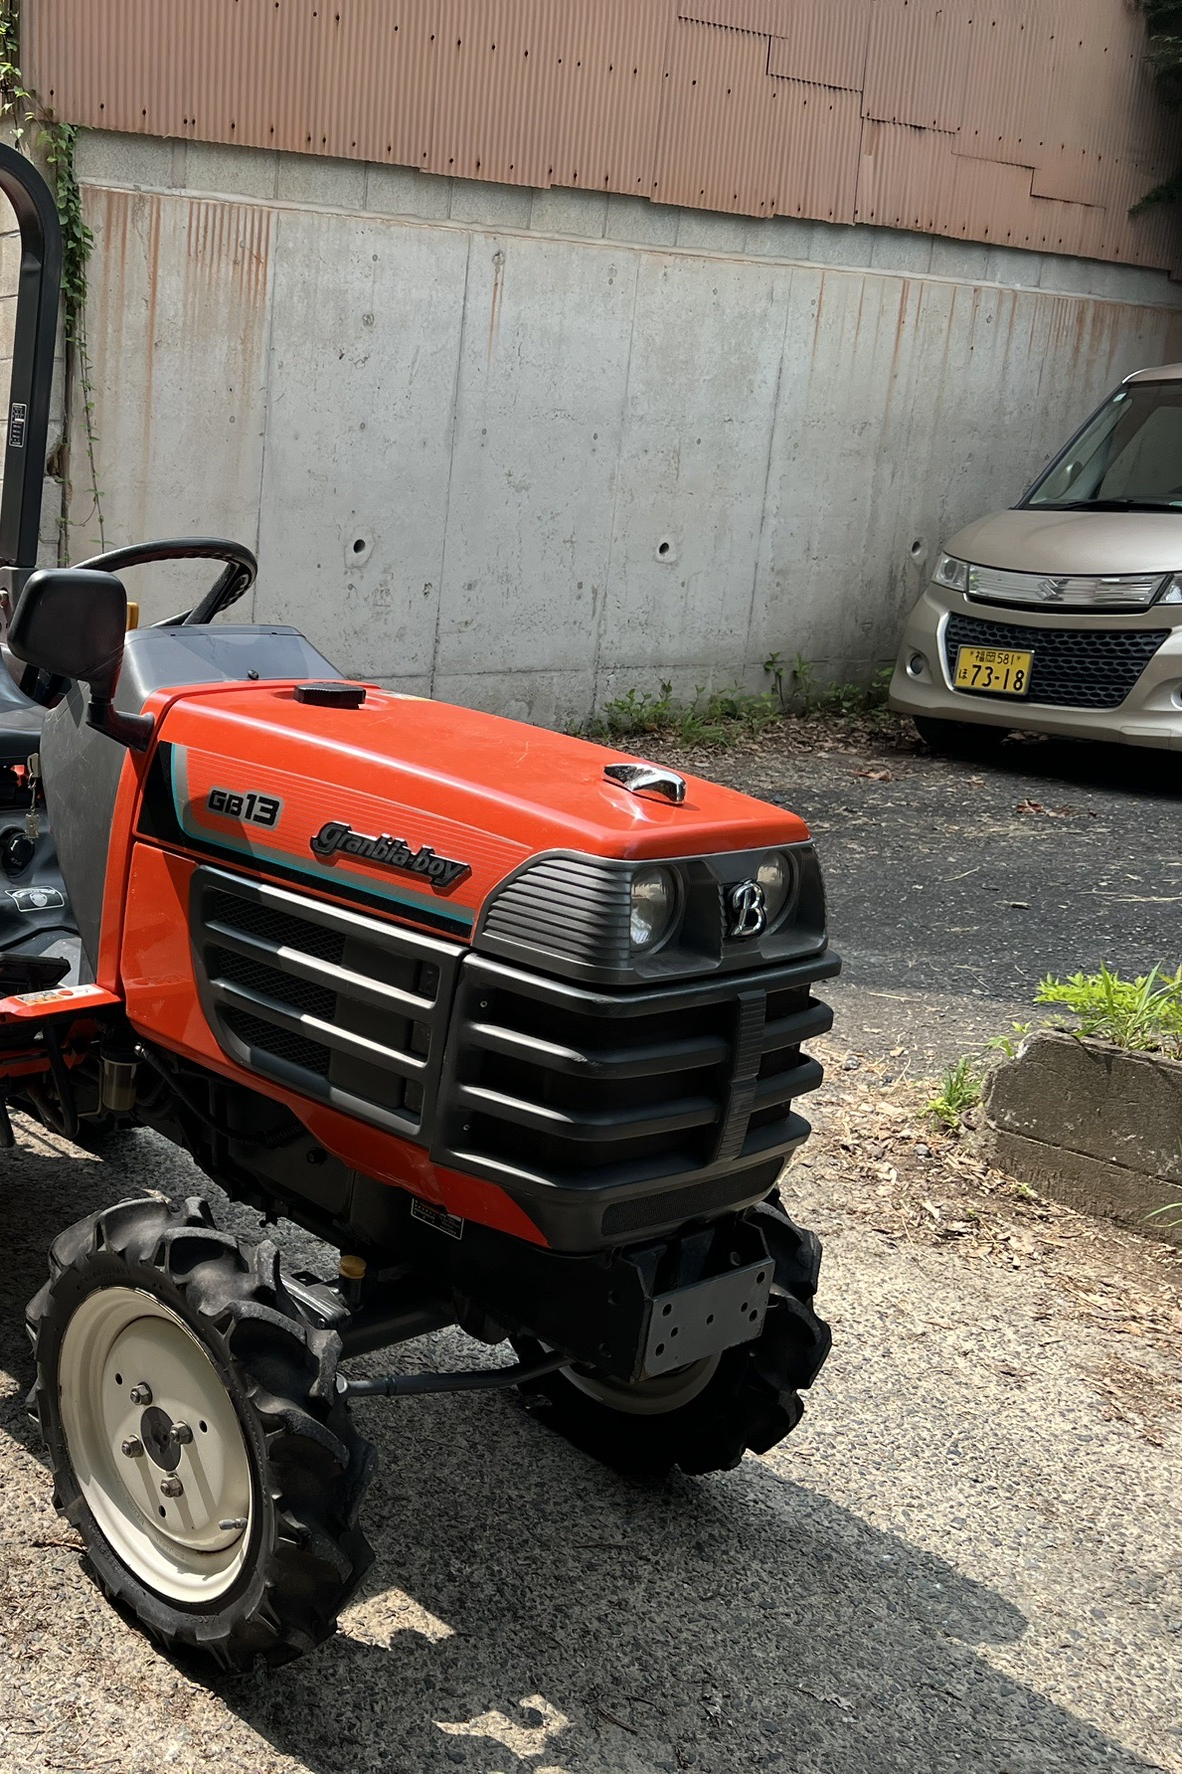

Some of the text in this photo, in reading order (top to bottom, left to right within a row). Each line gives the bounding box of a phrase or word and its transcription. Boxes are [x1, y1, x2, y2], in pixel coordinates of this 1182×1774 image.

[976, 650, 1015, 665] 福岡 581
[959, 664, 1025, 691] ほ 73-18
[208, 789, 280, 826] GB13
